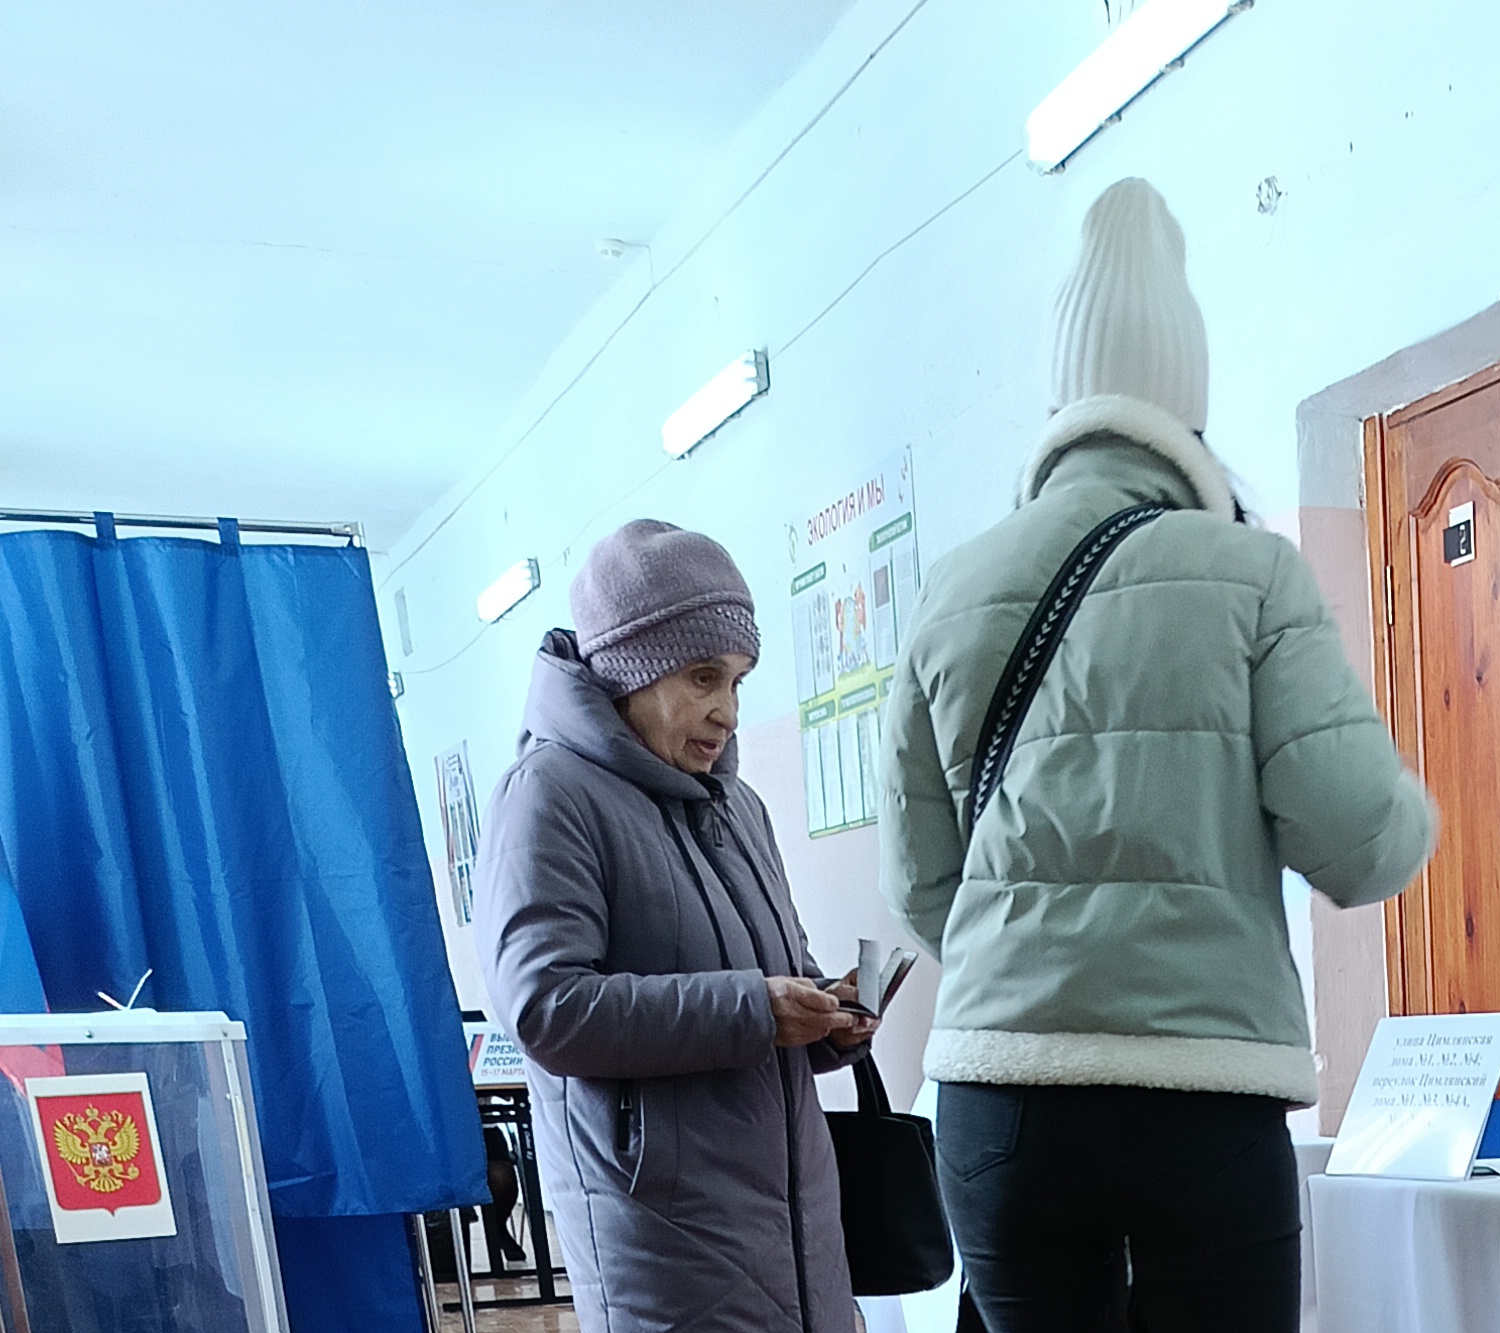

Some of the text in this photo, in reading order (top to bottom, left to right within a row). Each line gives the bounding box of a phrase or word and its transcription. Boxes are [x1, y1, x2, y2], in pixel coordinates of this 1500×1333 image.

[807, 491, 857, 546] ЭКОЛОГИЯ
[857, 486, 866, 516] И
[866, 473, 885, 510] МЫ
[1392, 1033, 1494, 1051] улица Цимлянская
[483, 1057, 524, 1067] РОССИИ
[1371, 1073, 1488, 1091] переулок Цимлянский
